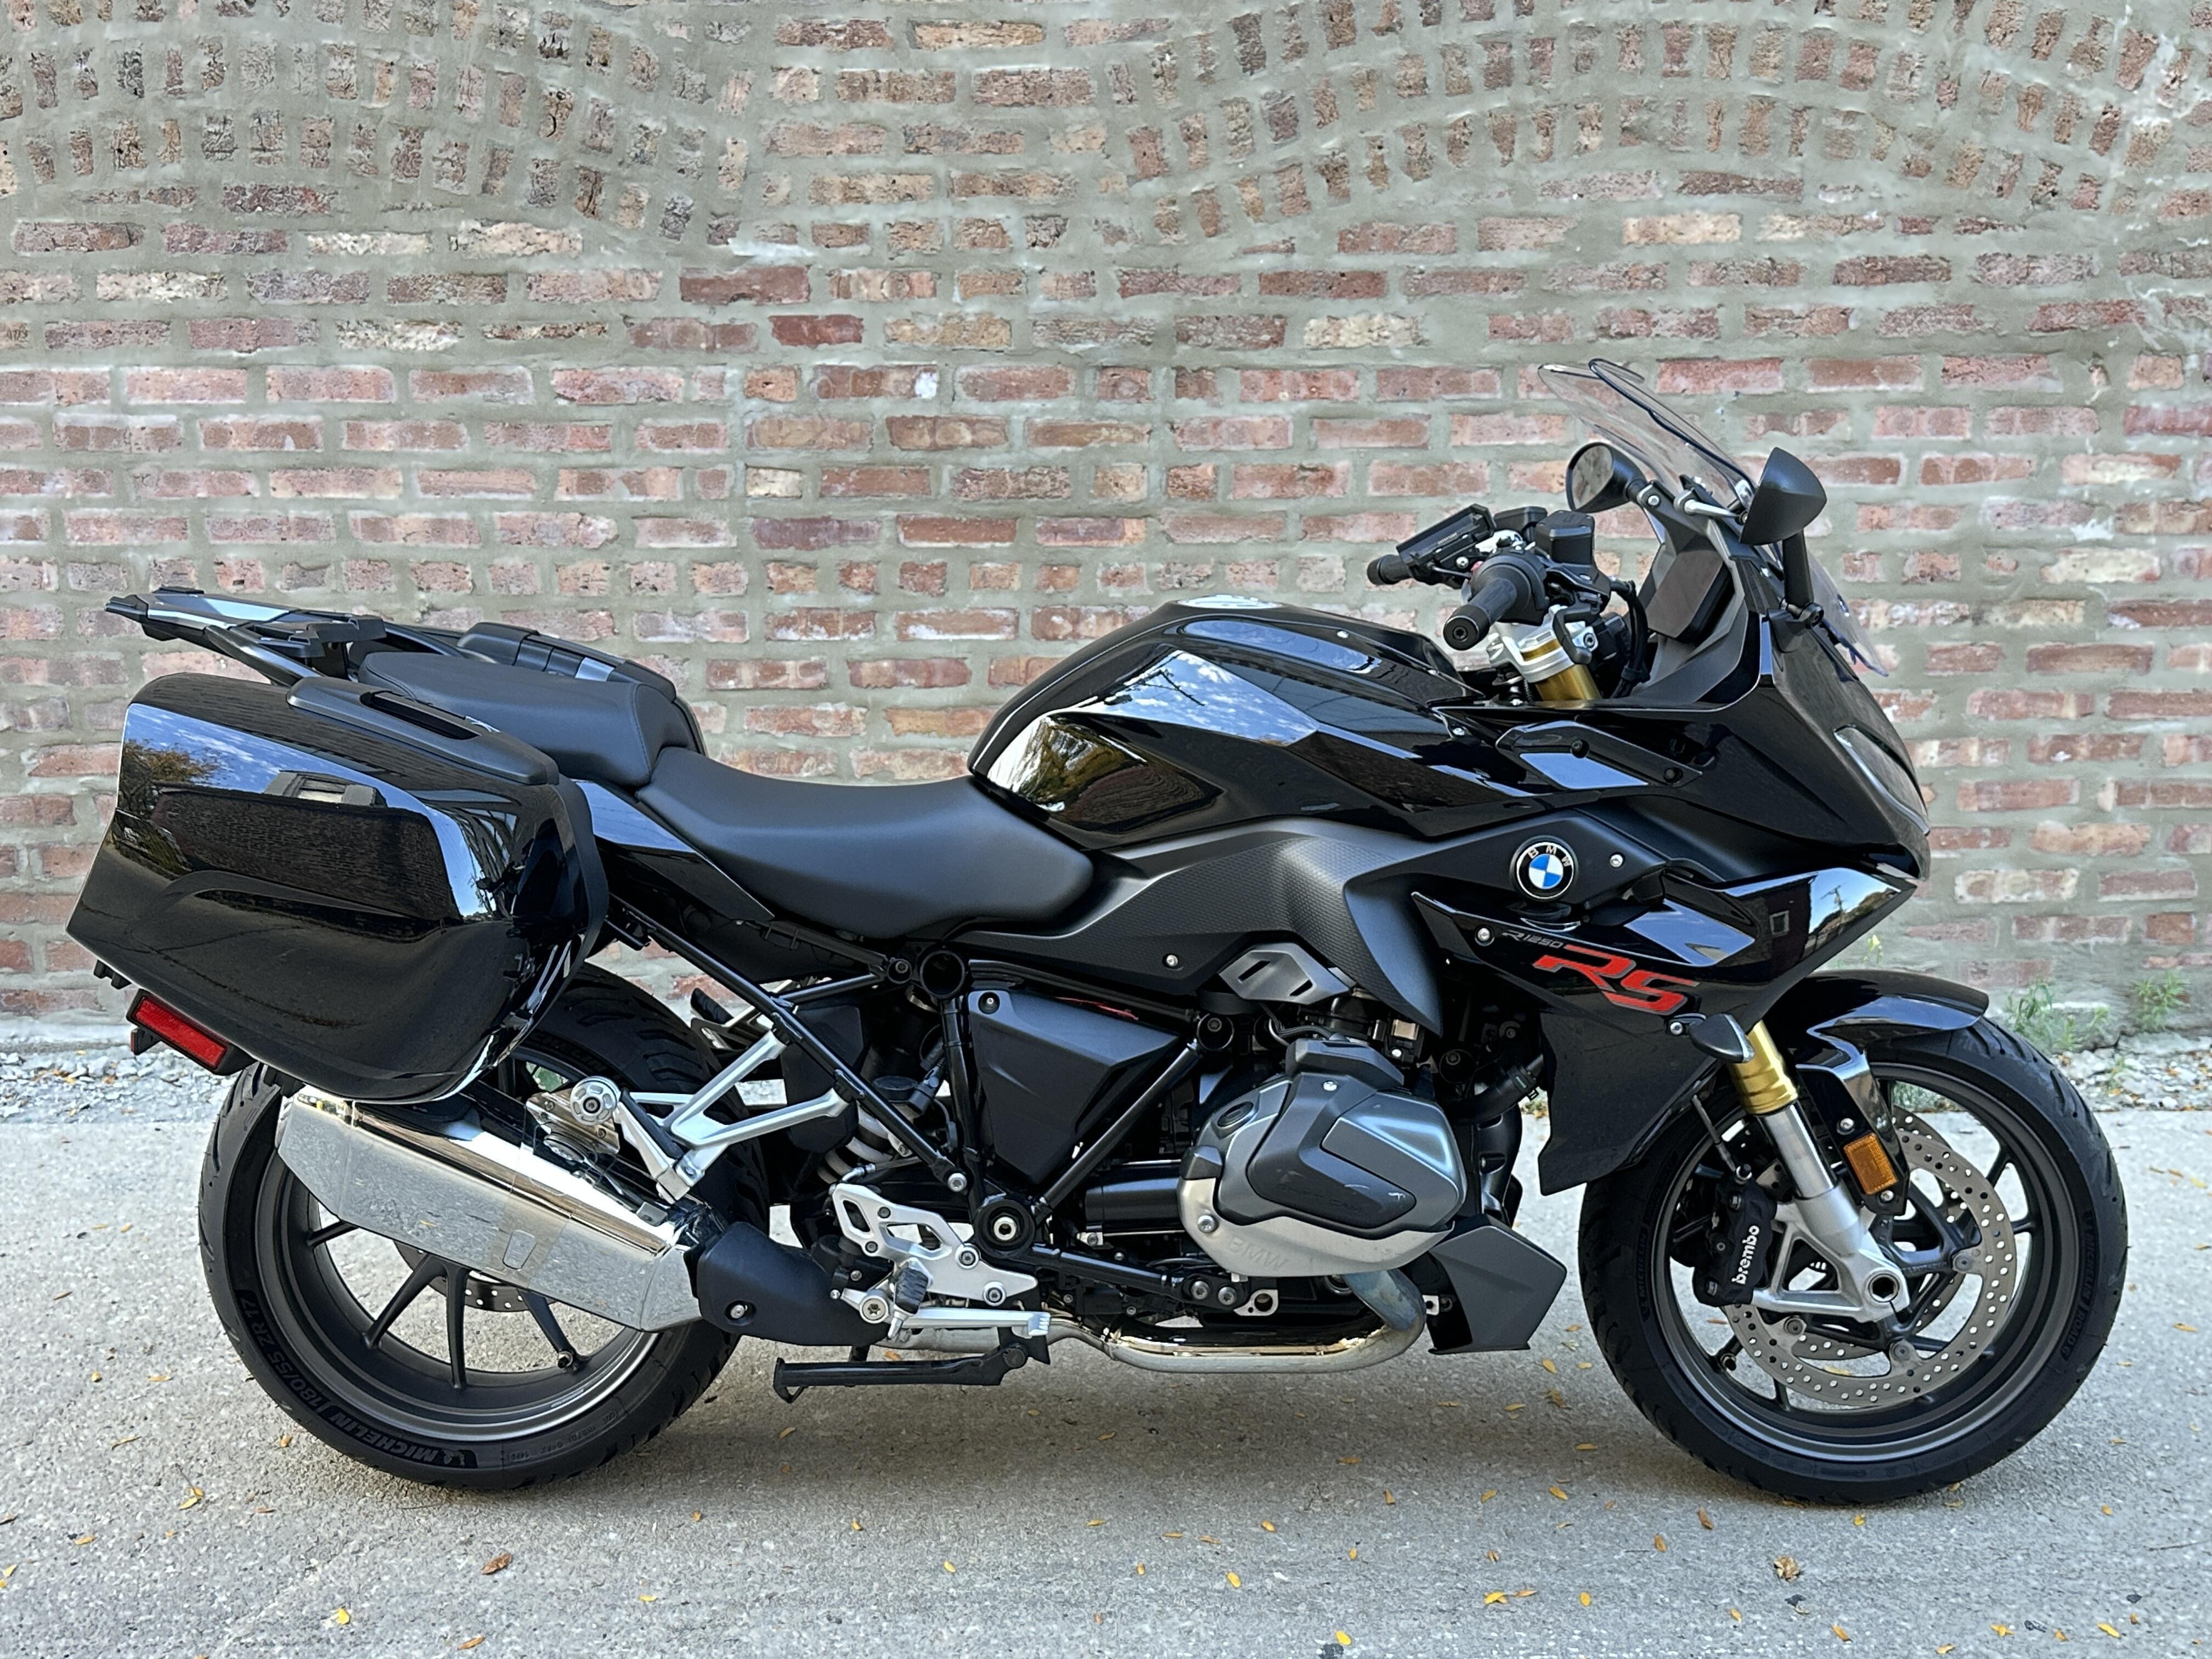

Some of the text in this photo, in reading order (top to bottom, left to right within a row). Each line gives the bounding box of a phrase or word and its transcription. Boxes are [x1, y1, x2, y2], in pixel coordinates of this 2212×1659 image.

[1528, 845, 1571, 867] BMW
[1532, 944, 1700, 1015] RS
[1226, 1235, 1290, 1271] BMW
[1731, 1225, 1760, 1285] brembo
[2082, 1235, 2095, 1299] MICHELIN
[2067, 1310, 2086, 1345] ROAD
[240, 1297, 438, 1463] MICHELIN 180/55 ZR 17
